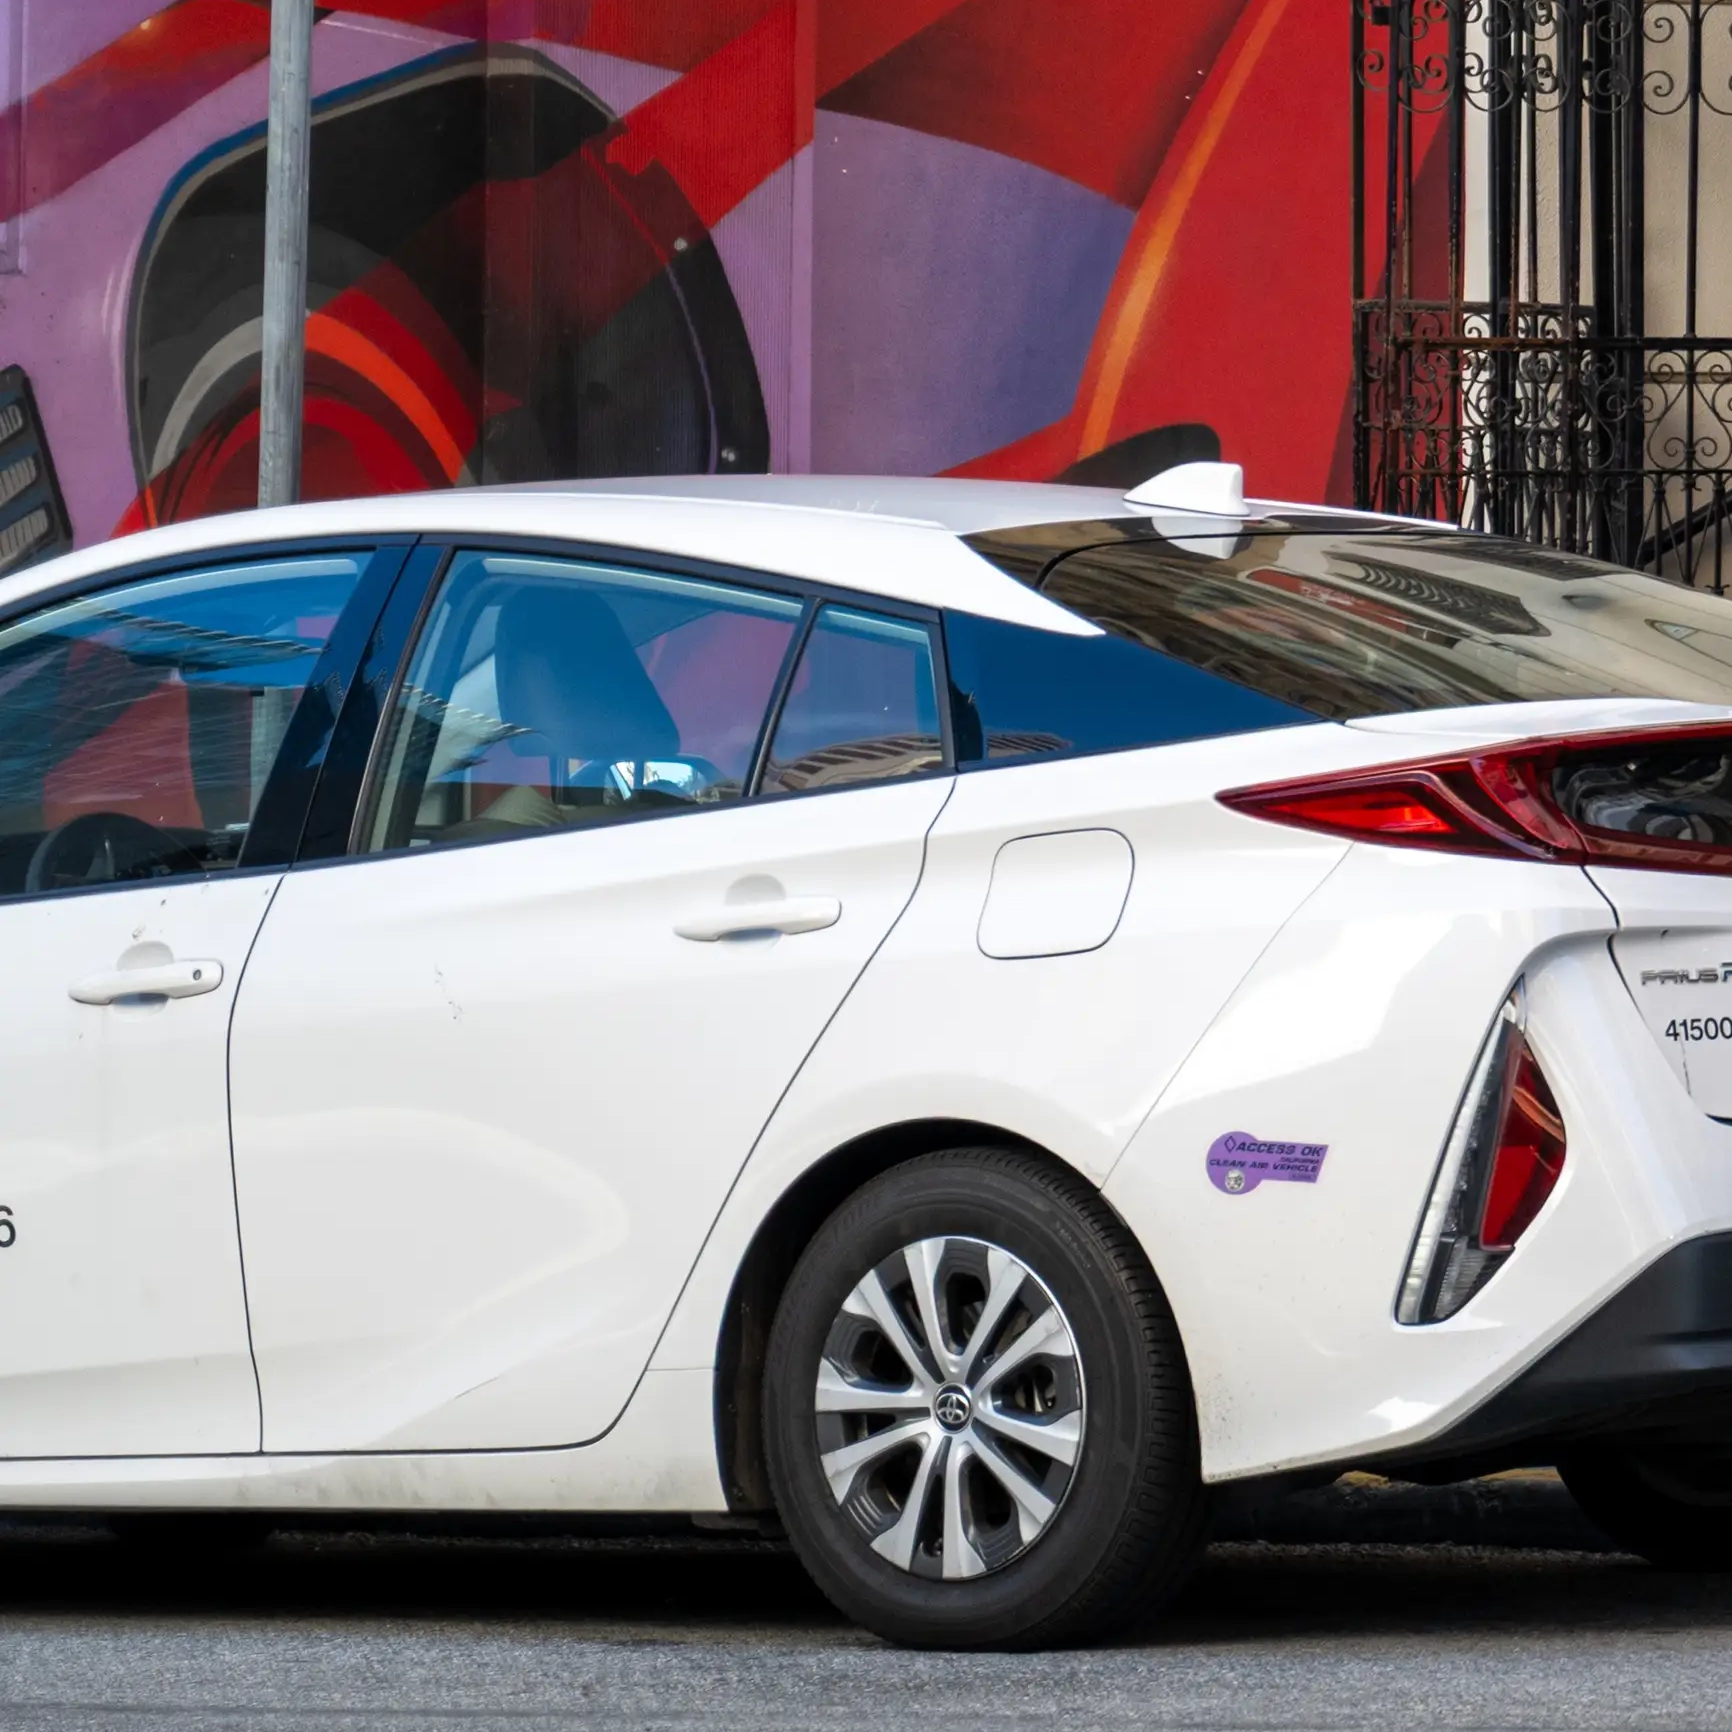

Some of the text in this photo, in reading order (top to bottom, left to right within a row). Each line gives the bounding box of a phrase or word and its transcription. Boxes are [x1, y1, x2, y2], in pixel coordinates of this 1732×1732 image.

[1641, 967, 1719, 986] PRIUS
[1235, 1142, 1322, 1157] ACCESS OK
[1209, 1159, 1318, 1173] CLEAN AIR VEHICLE
